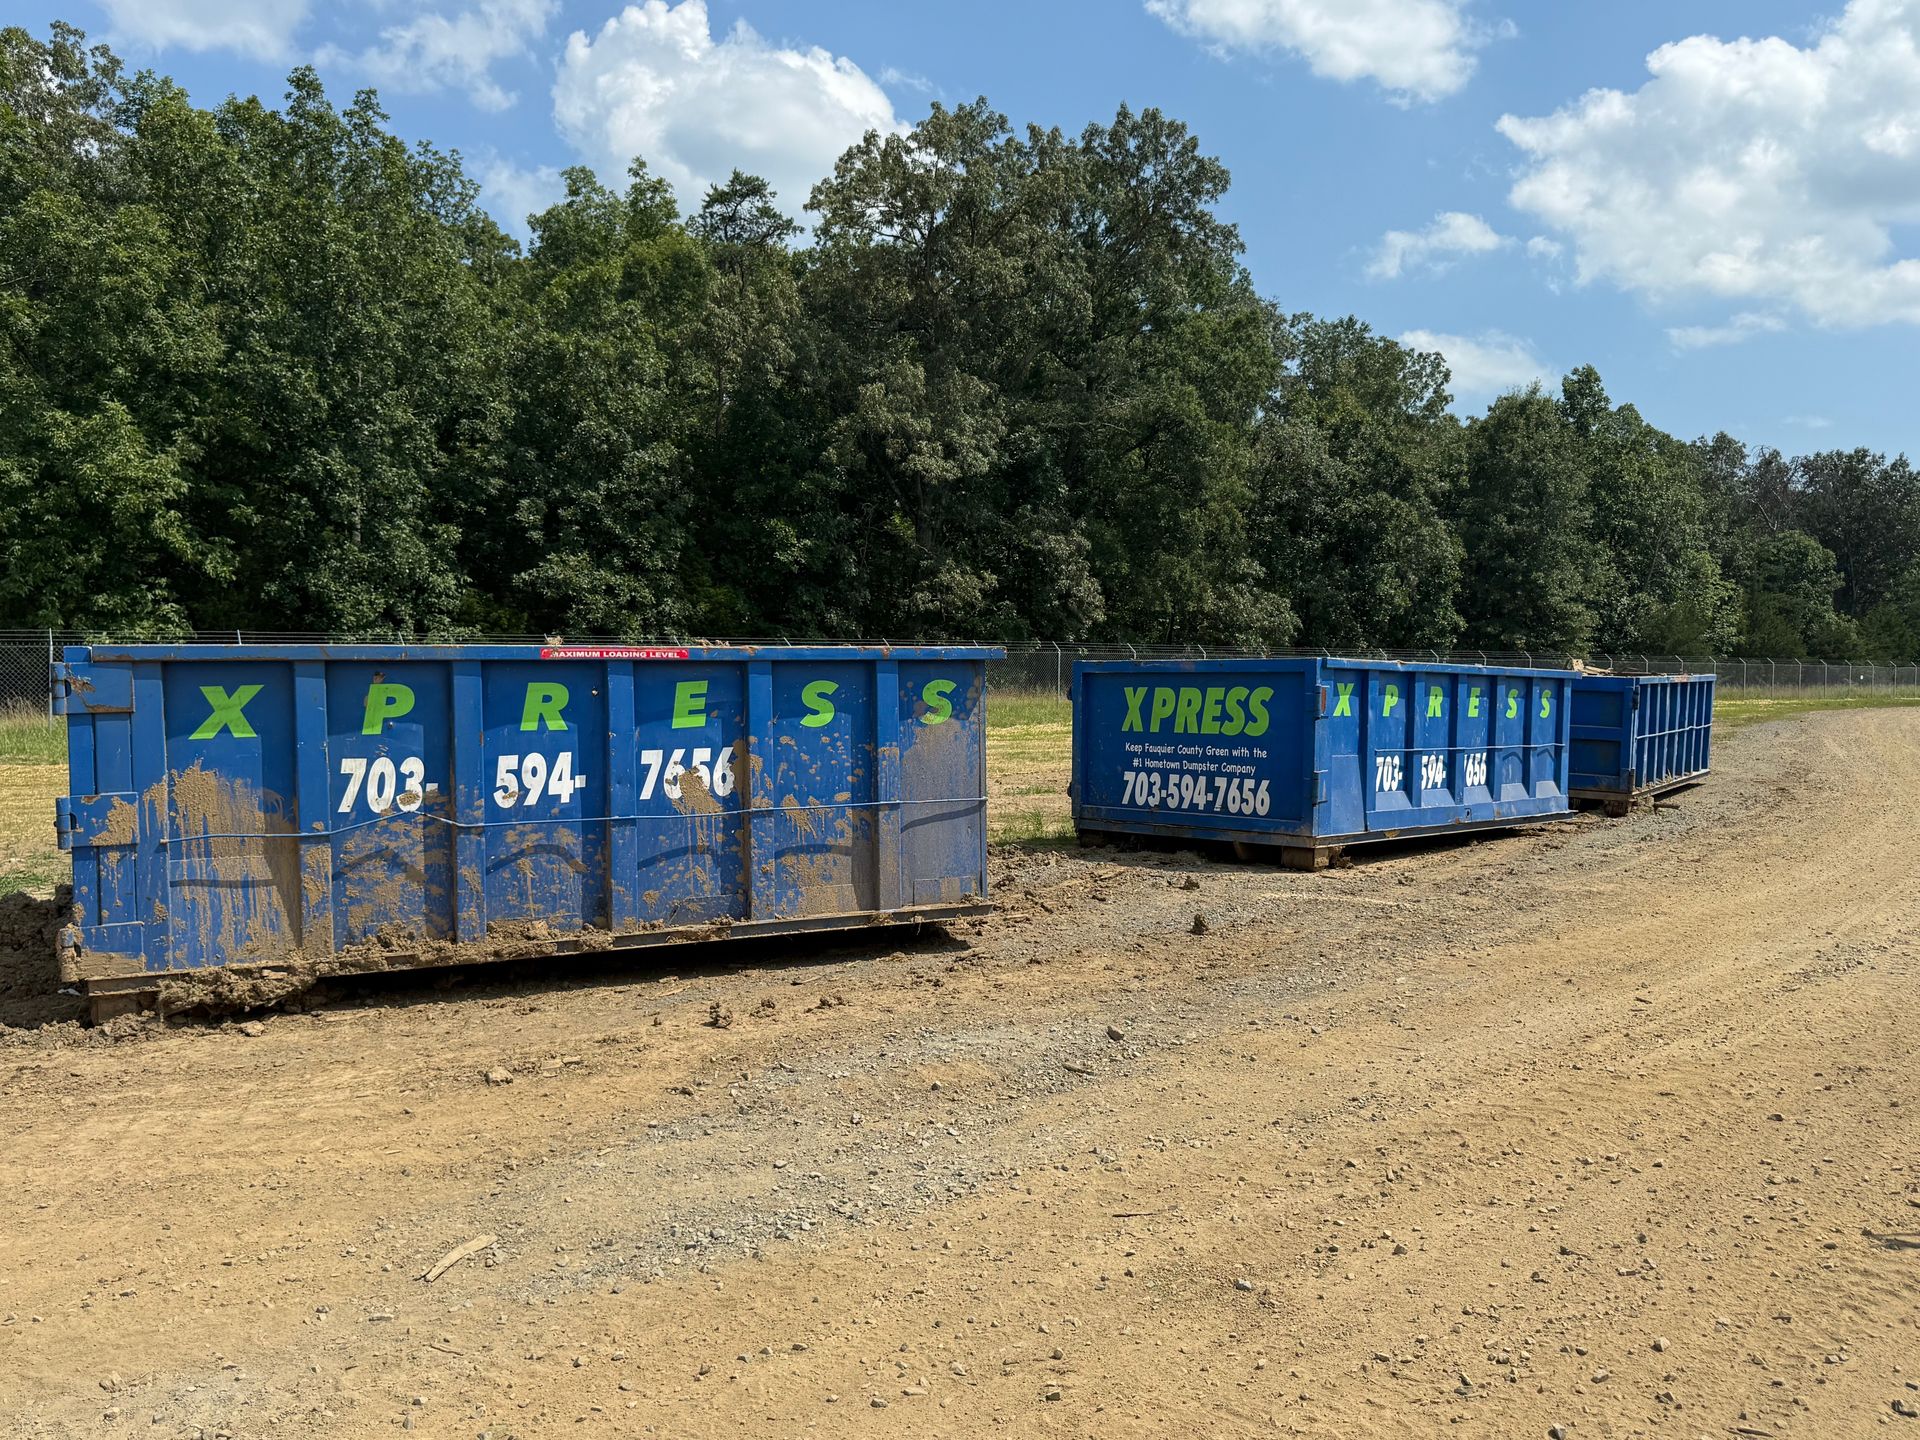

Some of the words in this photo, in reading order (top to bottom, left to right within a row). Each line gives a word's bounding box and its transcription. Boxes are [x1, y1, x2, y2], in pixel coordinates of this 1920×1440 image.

[1125, 742, 1143, 755] Keep
[1145, 743, 1175, 756] Fauquier
[1177, 744, 1204, 757] County
[1206, 745, 1229, 757] Green
[1232, 746, 1250, 758] with
[1253, 747, 1268, 759] the
[1132, 758, 1143, 768] #1
[1145, 758, 1180, 770] Hometown
[1182, 760, 1219, 774] Dumpster
[1221, 762, 1256, 776] Company
[640, 747, 735, 800] 7656
[1464, 752, 1487, 787] 656
[1121, 771, 1270, 816] 703-594-7656
